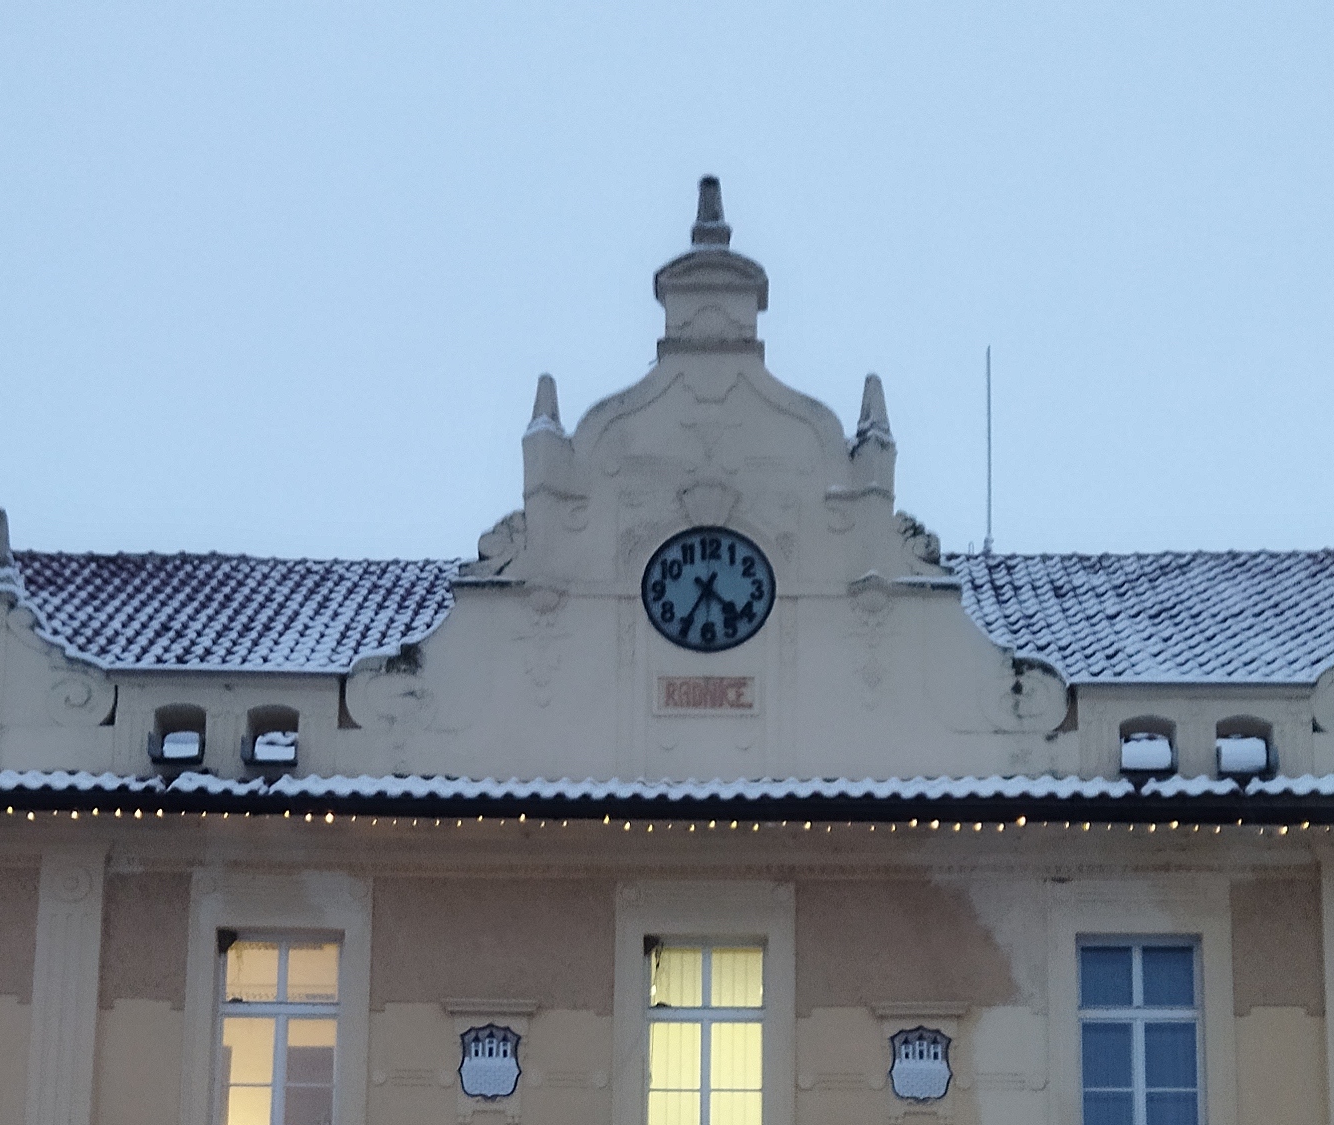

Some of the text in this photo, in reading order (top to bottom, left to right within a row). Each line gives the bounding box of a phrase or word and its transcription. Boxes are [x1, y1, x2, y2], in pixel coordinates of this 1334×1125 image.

[681, 543, 695, 565] 11
[700, 537, 722, 560] 12
[728, 542, 736, 566] 1
[660, 559, 683, 581] 10
[742, 556, 756, 578] 2
[652, 581, 665, 601] 9
[750, 578, 764, 601] 3
[661, 601, 675, 622] 8
[740, 601, 756, 623] 4
[680, 616, 695, 637] 7
[700, 621, 716, 643] 6
[723, 613, 738, 638] 5
